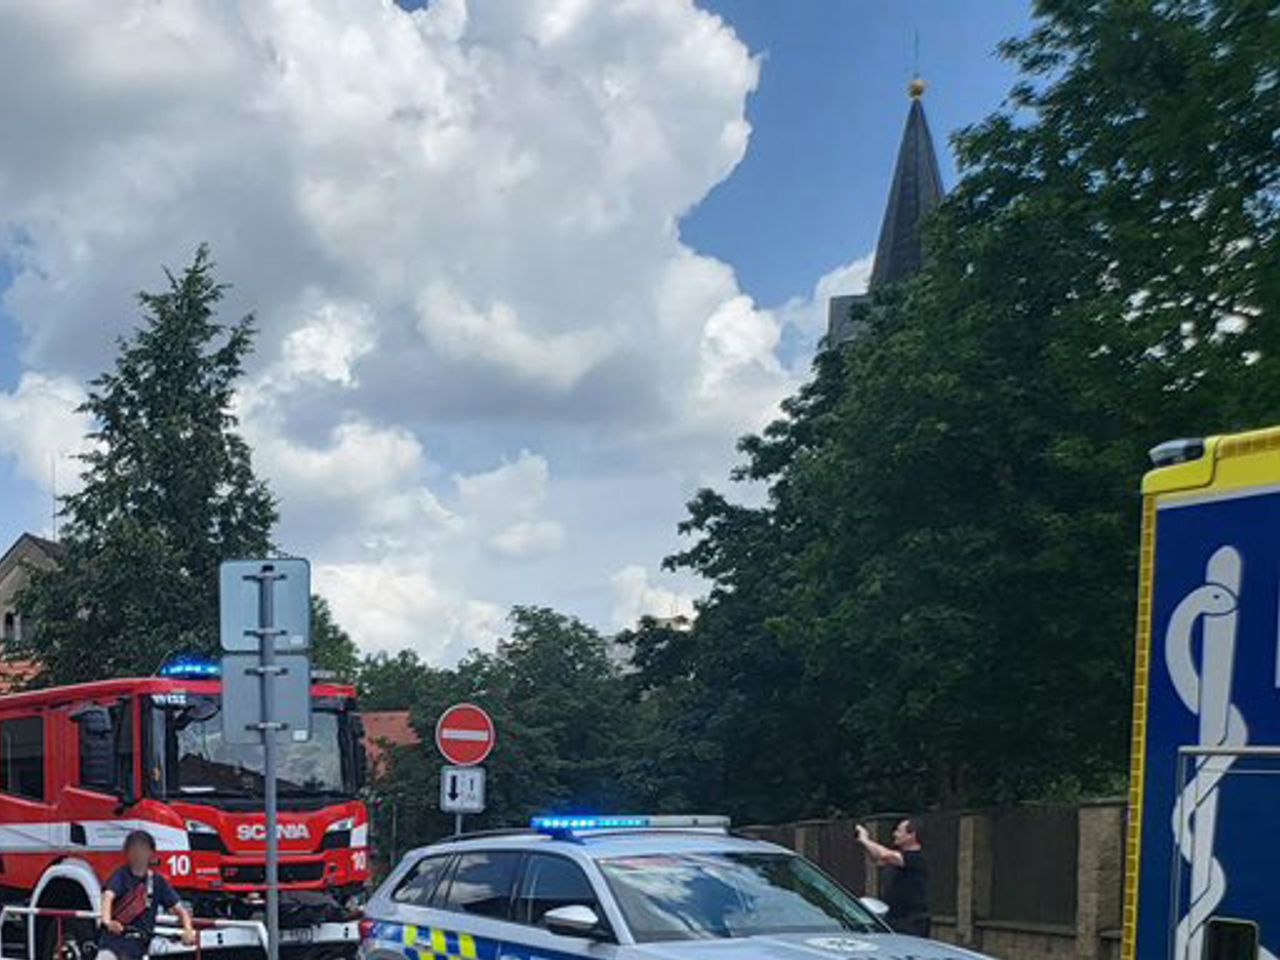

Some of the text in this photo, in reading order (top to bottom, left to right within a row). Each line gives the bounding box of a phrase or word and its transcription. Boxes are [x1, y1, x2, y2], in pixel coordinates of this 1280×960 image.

[236, 823, 311, 841] SCNIA
[167, 854, 191, 877] 10
[352, 850, 366, 871] 10
